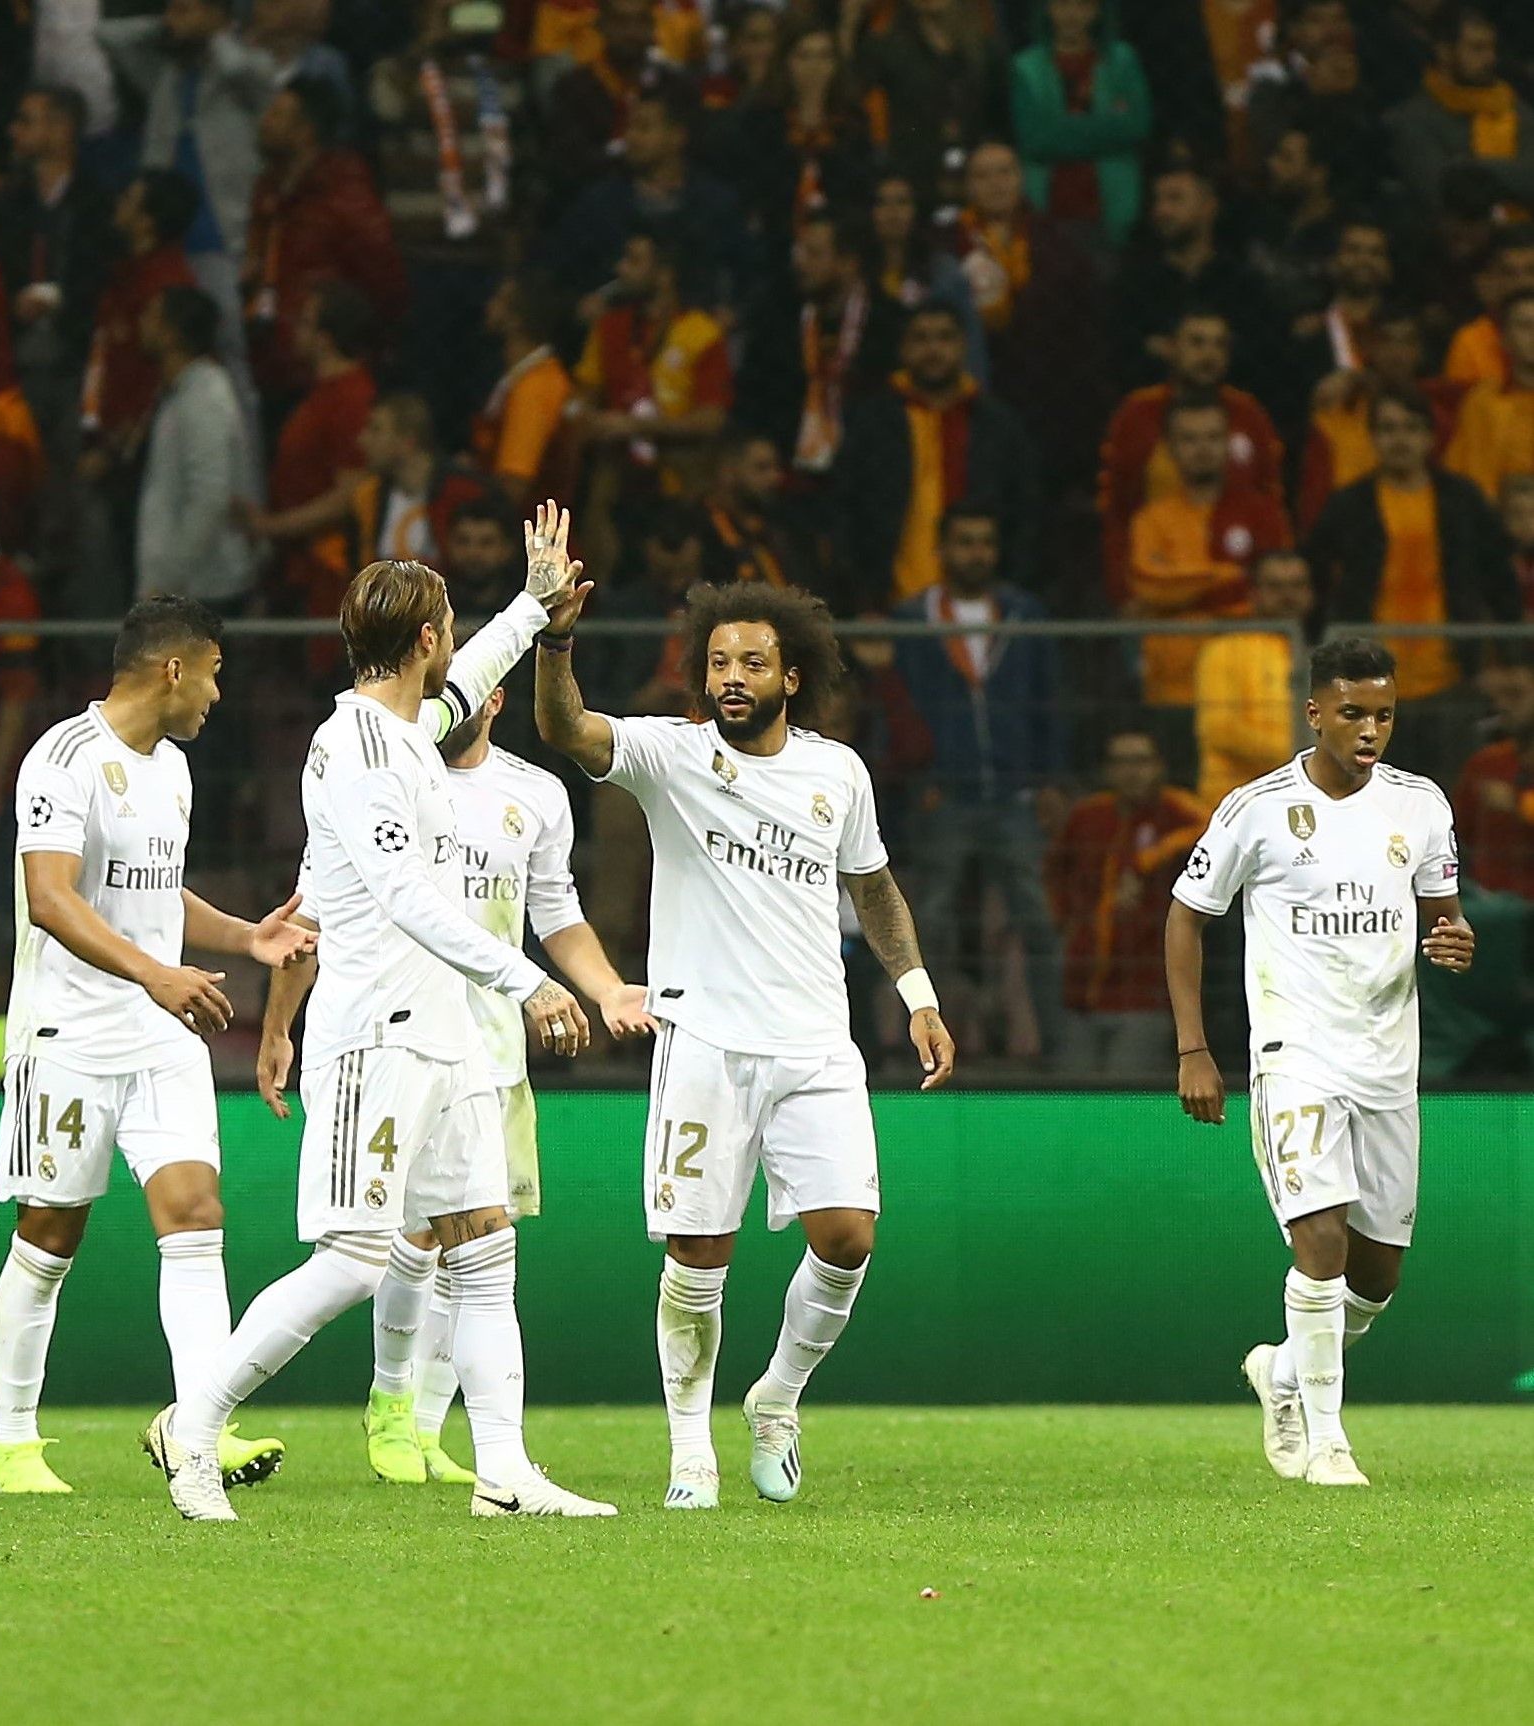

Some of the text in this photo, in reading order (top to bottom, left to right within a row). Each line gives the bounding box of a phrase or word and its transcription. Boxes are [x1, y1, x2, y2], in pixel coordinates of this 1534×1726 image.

[148, 836, 175, 860] Fly
[461, 845, 489, 870] ly
[706, 829, 829, 886] Emirates
[755, 820, 796, 852] Fly
[1336, 881, 1374, 902] Fly
[37, 1093, 86, 1150] 14
[368, 1116, 398, 1172] 4
[658, 1119, 709, 1179] 12
[1272, 1104, 1326, 1165] 27
